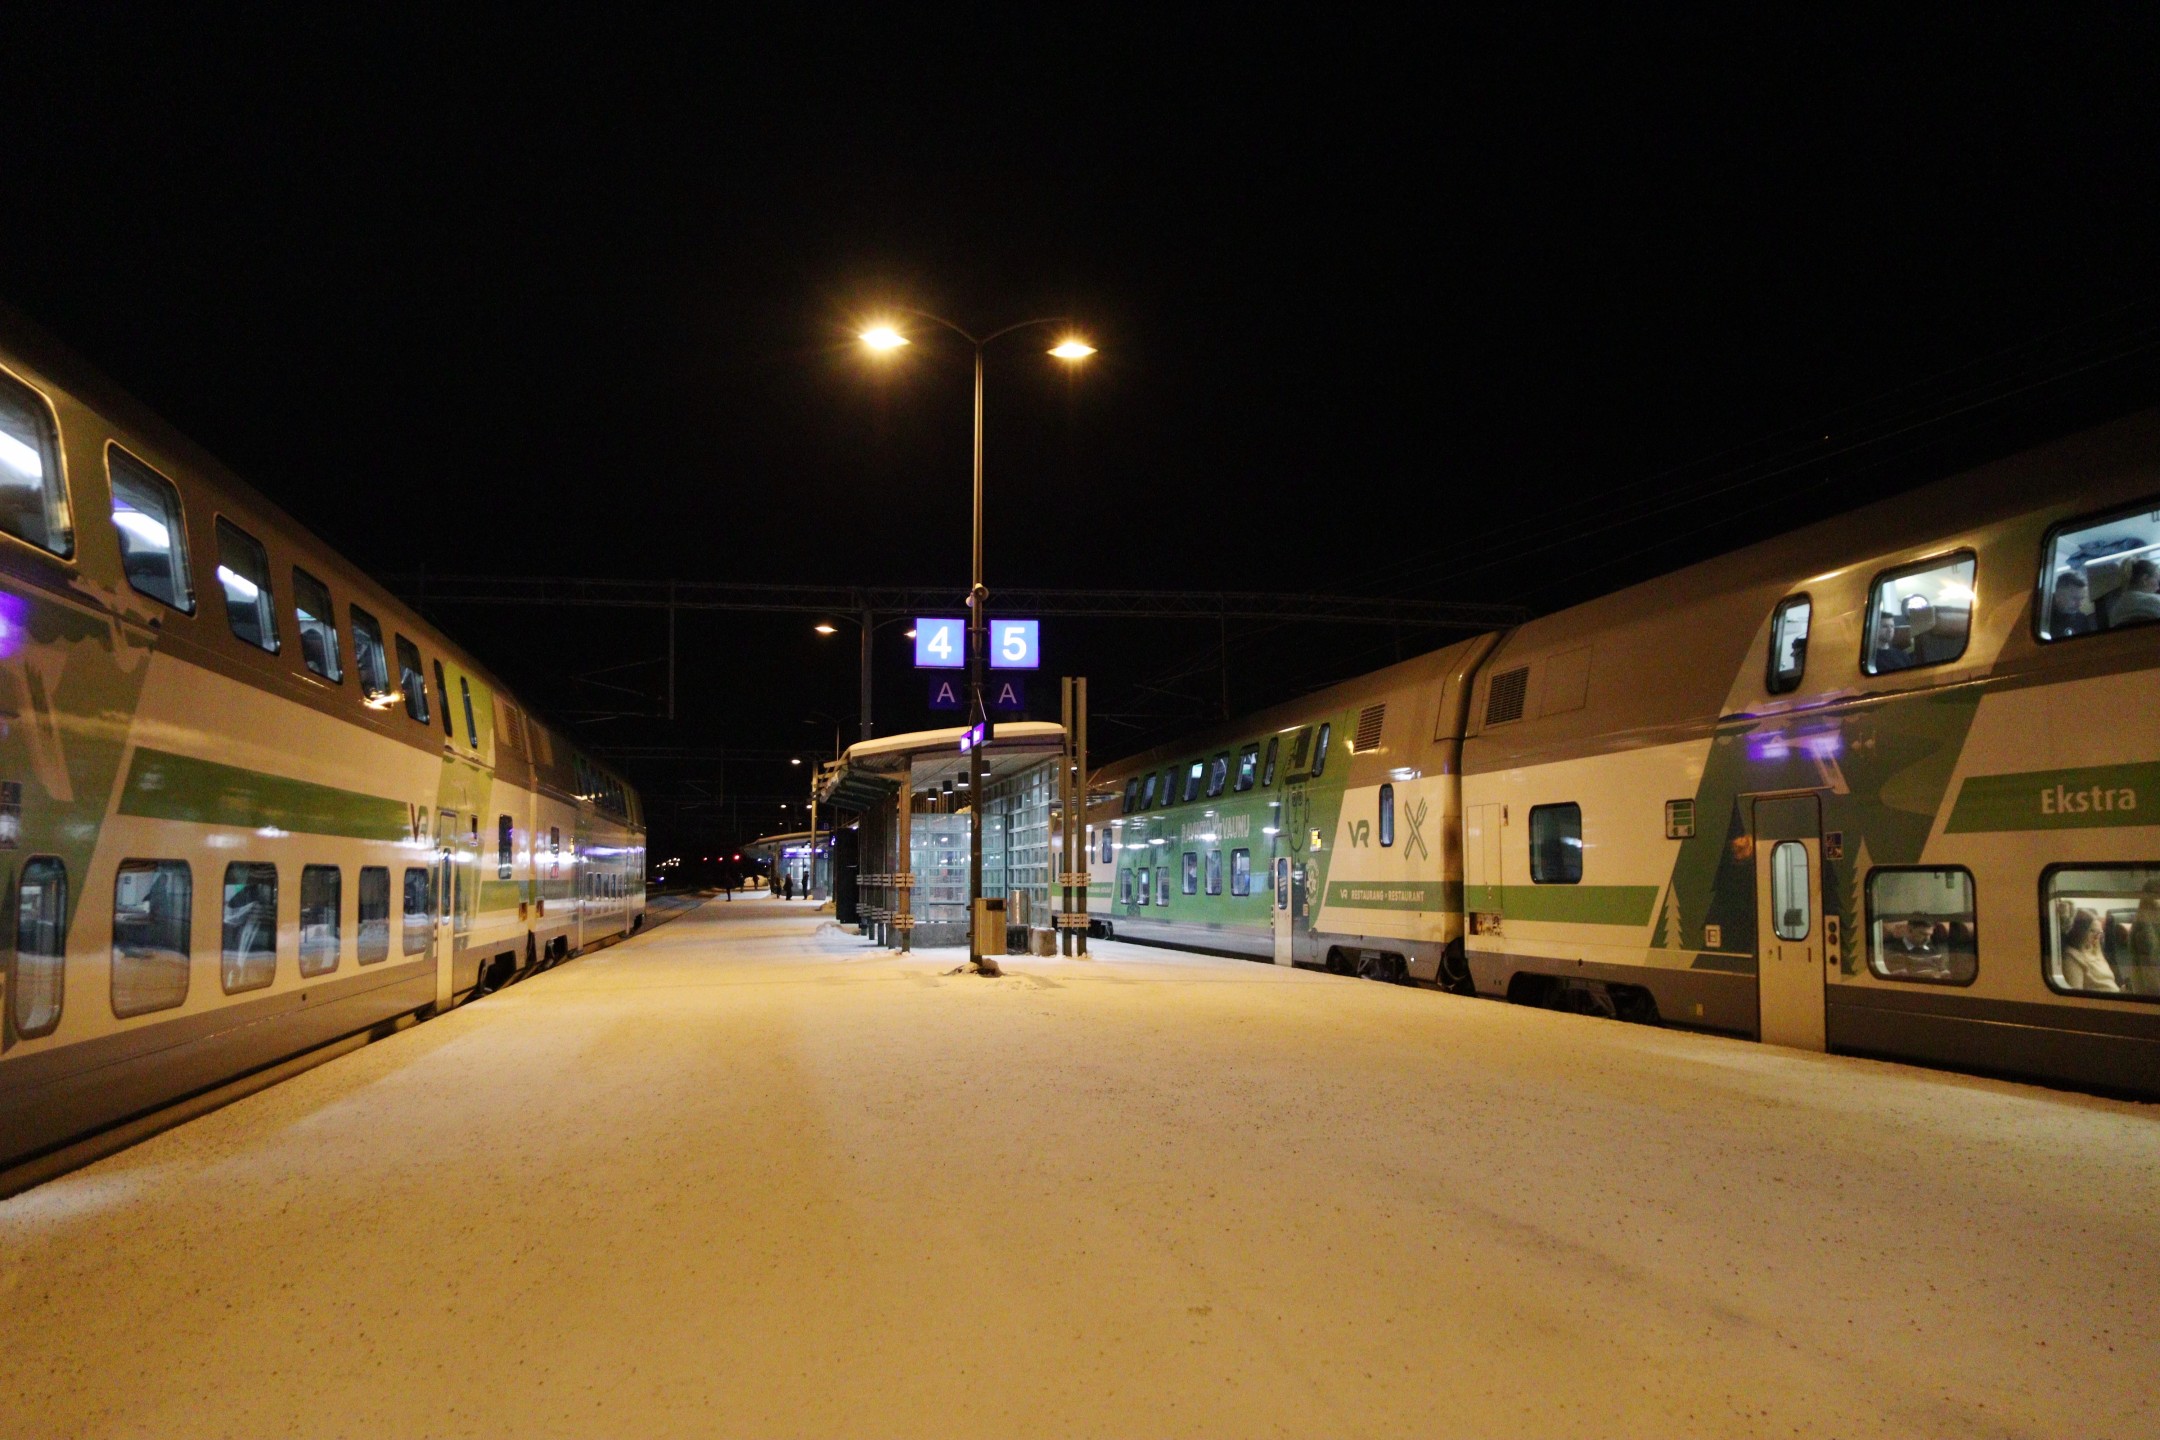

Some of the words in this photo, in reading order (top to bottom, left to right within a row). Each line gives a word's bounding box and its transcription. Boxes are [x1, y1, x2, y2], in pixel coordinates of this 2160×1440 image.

[927, 625, 952, 660] 4
[1002, 626, 1027, 661] 5
[936, 681, 956, 703] A
[998, 682, 1017, 704] A
[2041, 784, 2137, 814] Ekstra
[1347, 819, 1370, 849] VR
[1340, 889, 1348, 900] VR
[1707, 929, 1717, 943] E
